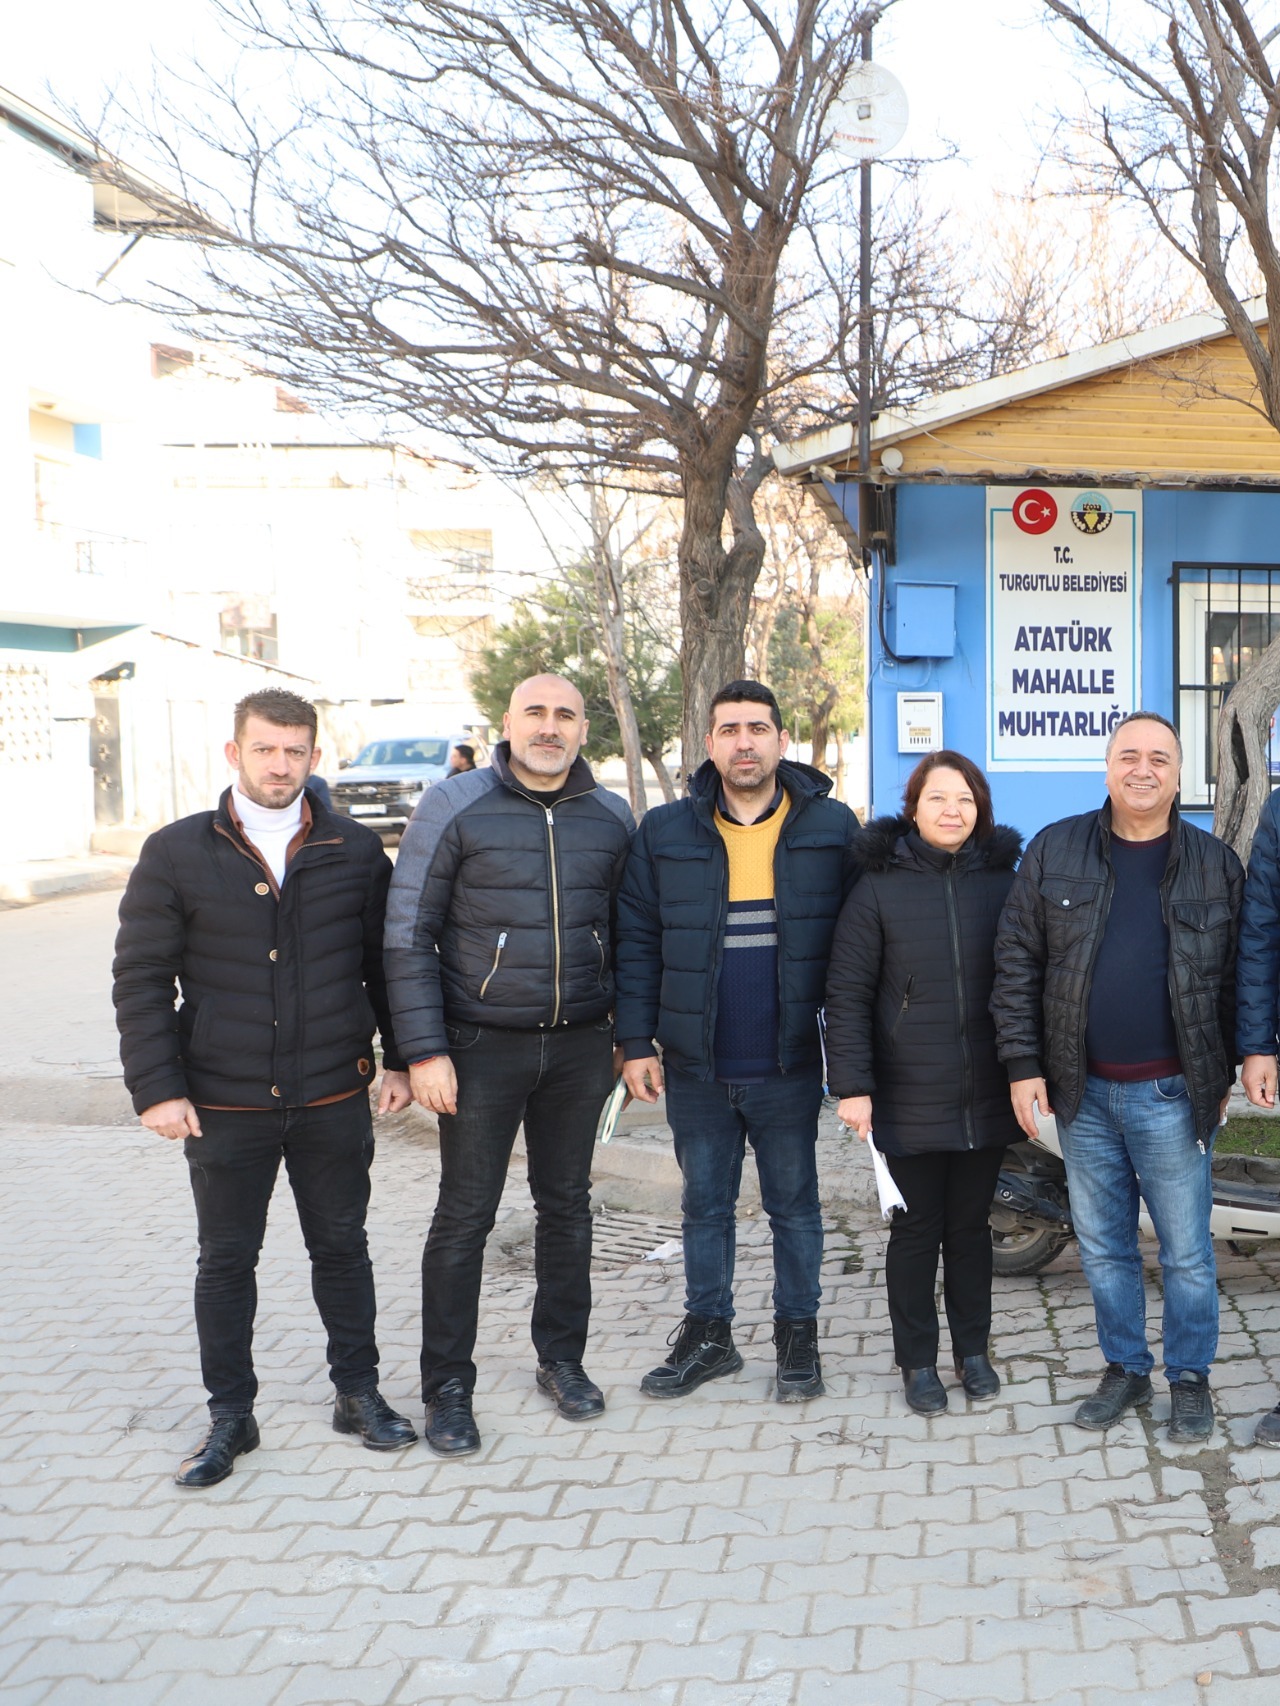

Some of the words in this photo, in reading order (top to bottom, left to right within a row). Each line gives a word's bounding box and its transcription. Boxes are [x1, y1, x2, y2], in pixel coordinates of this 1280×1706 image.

[1053, 546, 1074, 564] T.C.
[999, 574, 1060, 592] TURGUTLU
[1062, 571, 1127, 593] BELEDİYESİ
[1014, 620, 1113, 652] ATATÜRK
[1012, 669, 1115, 694] MAHALLE
[999, 704, 1128, 736] MUHTARLIĞ
